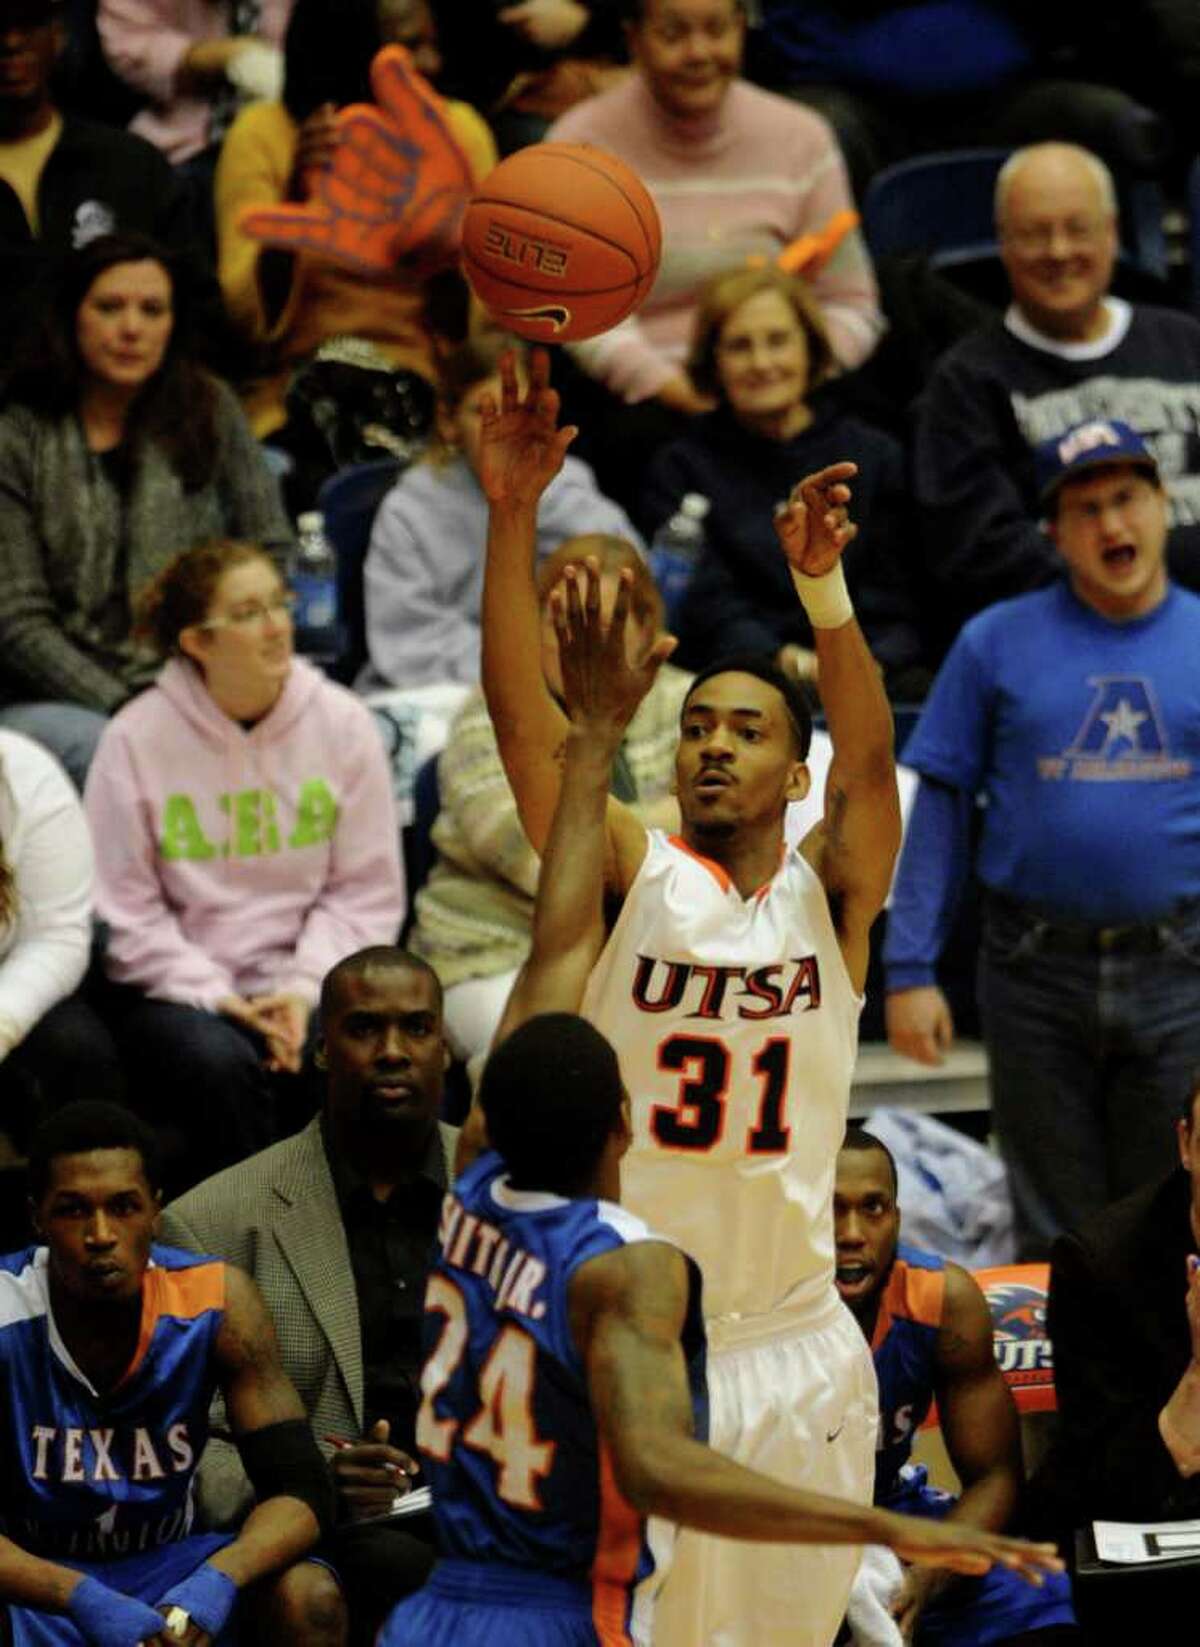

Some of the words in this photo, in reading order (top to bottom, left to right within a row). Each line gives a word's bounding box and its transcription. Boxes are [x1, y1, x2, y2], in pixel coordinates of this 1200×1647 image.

[484, 223, 568, 278] ELITE
[631, 952, 822, 1021] UTSA
[649, 1031, 792, 1155] 31
[992, 1338, 1055, 1371] UTS
[415, 1272, 558, 1512] 24
[32, 1423, 194, 1482] TEXAS
